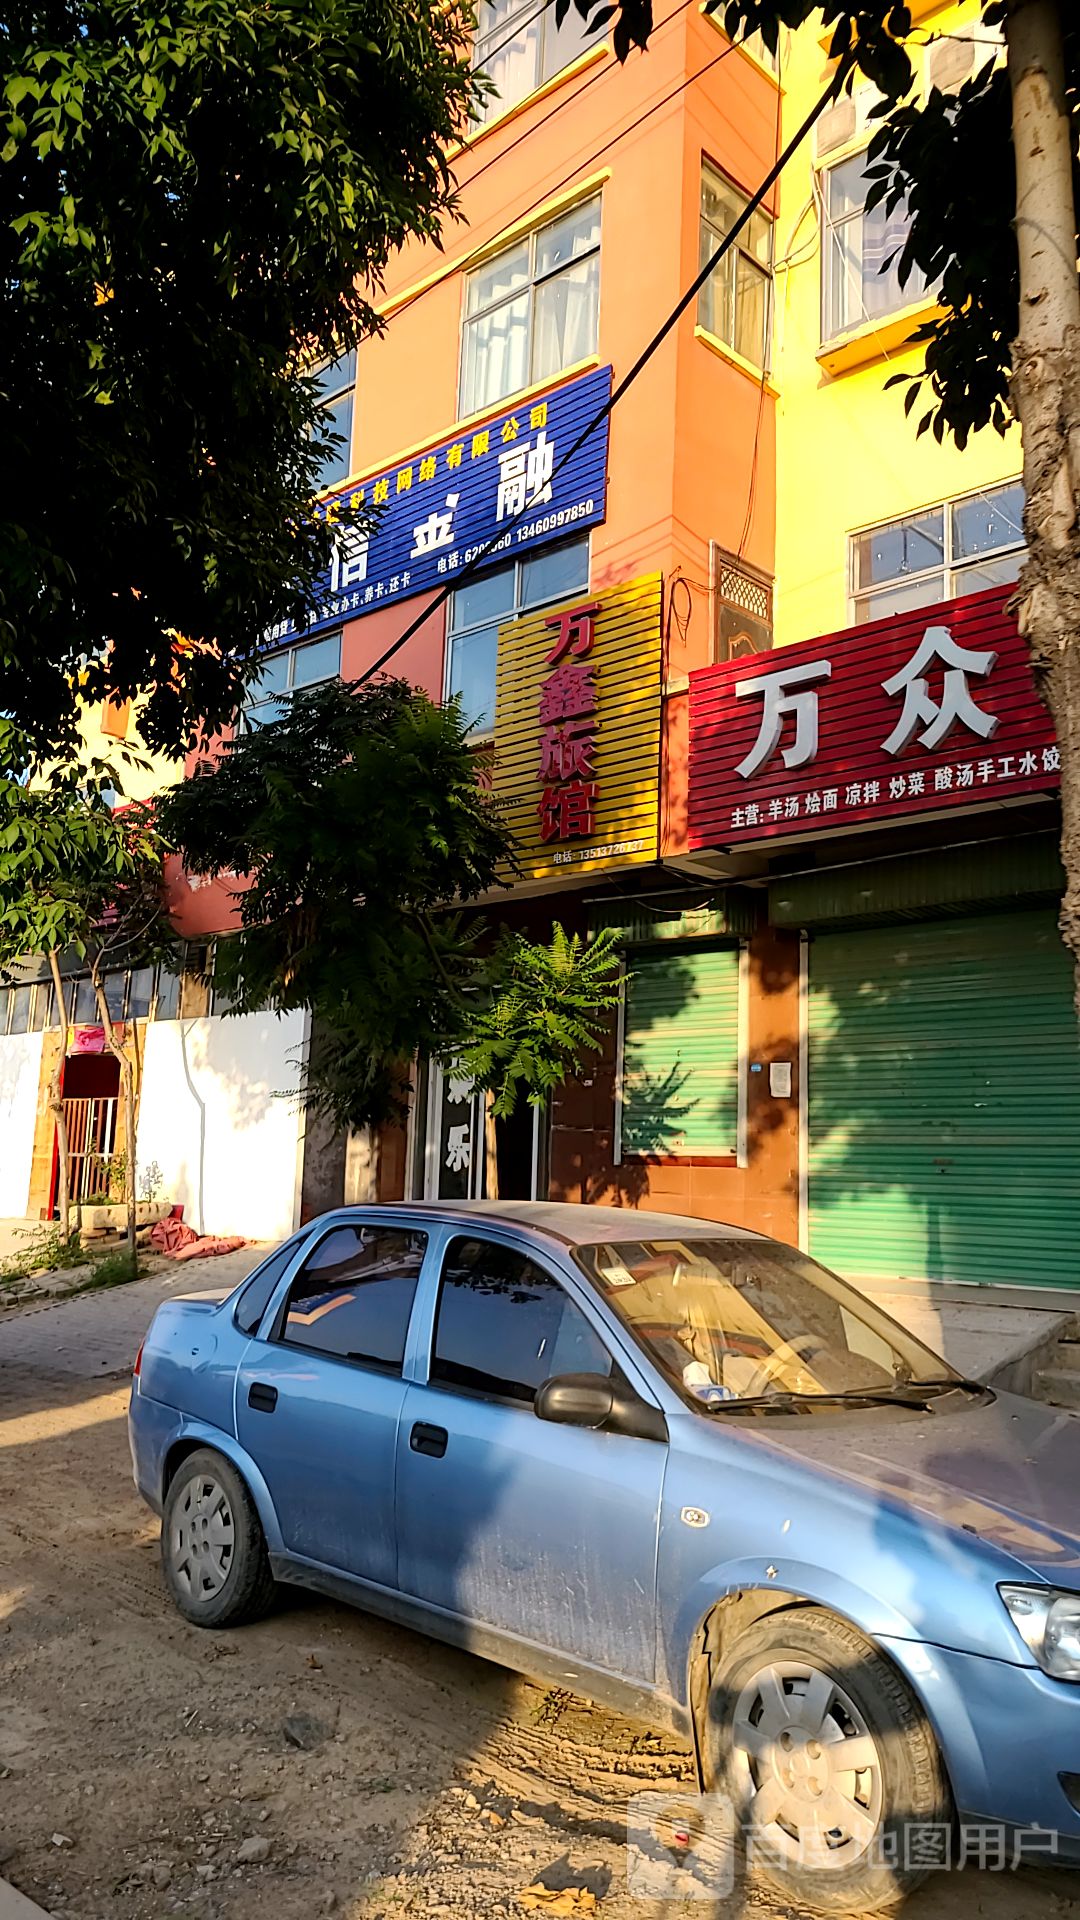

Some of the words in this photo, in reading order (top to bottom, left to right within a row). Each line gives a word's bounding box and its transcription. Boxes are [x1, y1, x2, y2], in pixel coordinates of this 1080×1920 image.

[516, 499, 594, 542] 13460997850
[536, 602, 601, 841] 万鑫旅馆
[734, 626, 999, 779] 万众
[934, 746, 1061, 791] 酸汤手工水饺
